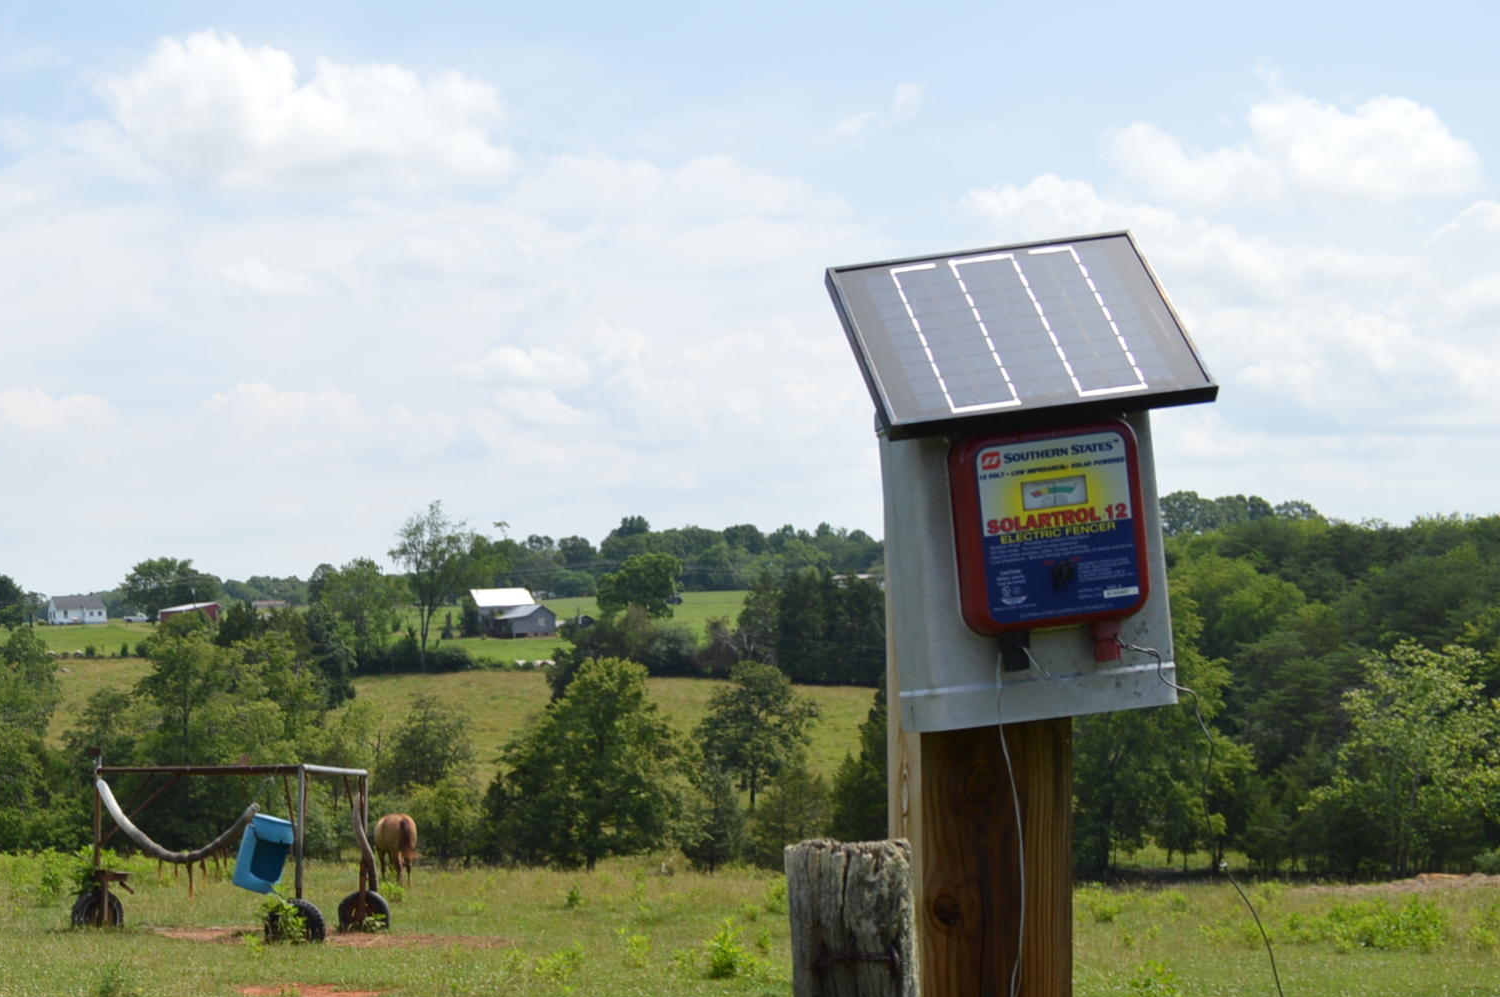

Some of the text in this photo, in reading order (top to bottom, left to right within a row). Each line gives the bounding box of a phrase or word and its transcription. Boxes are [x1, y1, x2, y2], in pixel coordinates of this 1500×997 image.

[1004, 447, 1068, 463] SOUTHERN
[989, 472, 1004, 480] VOLT
[1093, 457, 1125, 466] POWERED
[987, 502, 1128, 535] SOLARTROL 12
[1000, 527, 1062, 545] ELECTRIC
[1065, 520, 1116, 536] FENCER
